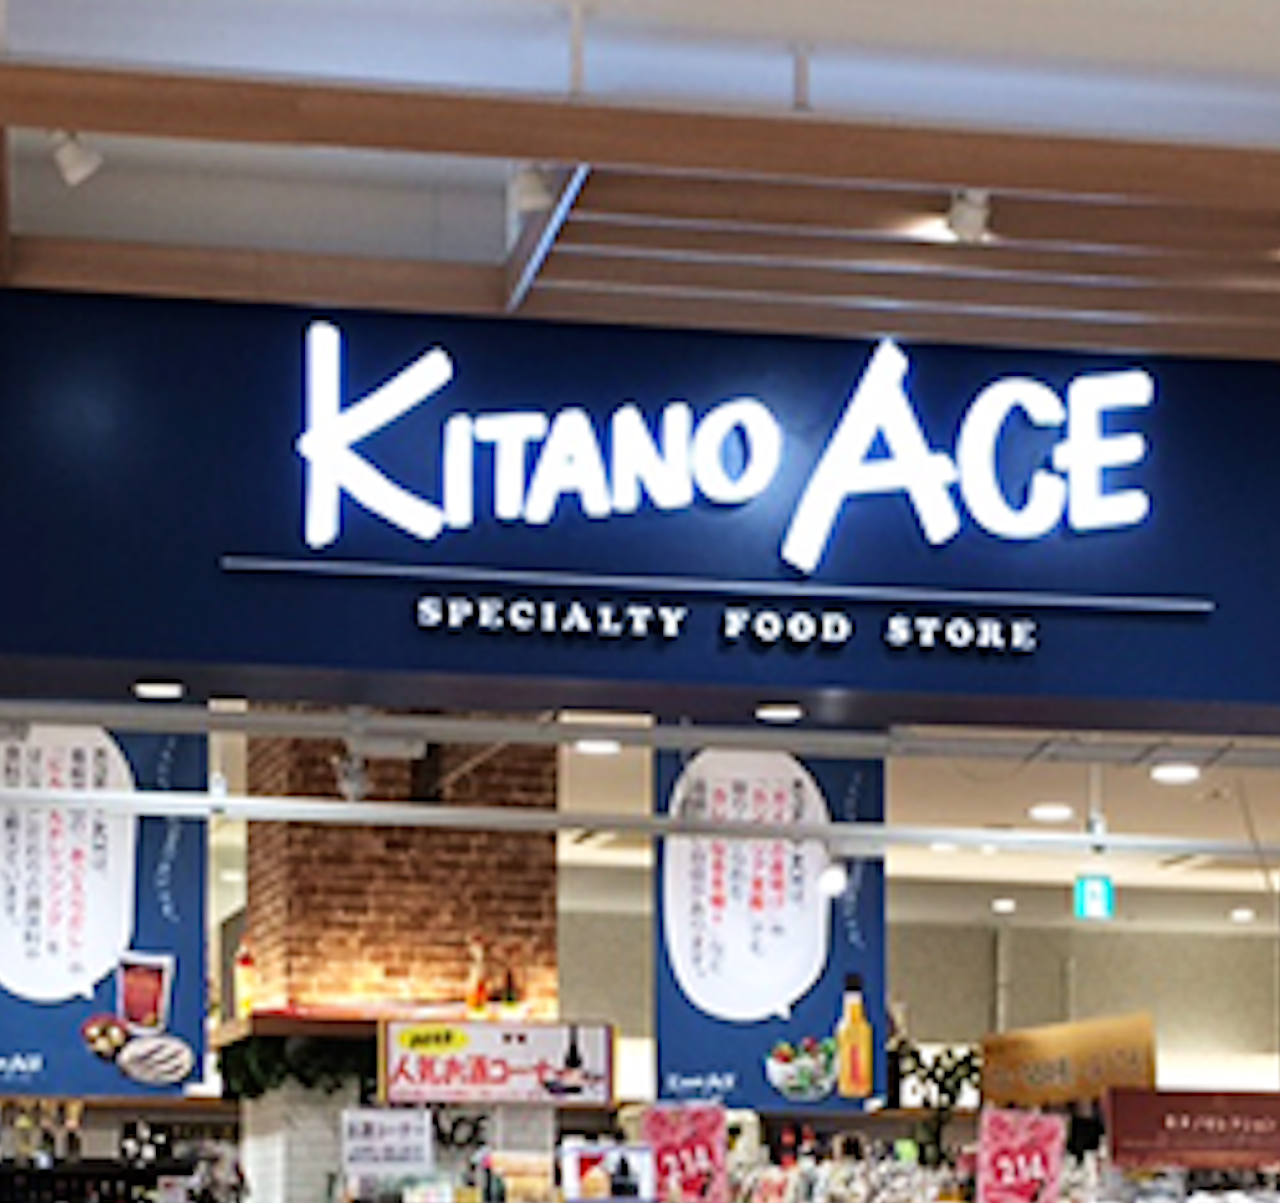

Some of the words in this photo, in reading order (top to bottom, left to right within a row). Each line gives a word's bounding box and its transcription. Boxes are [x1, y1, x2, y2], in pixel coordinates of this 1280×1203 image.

[297, 321, 783, 549] KITANO
[781, 336, 1155, 575] ACE
[417, 595, 688, 640] SPECIALTY
[723, 606, 853, 645] FOOD
[885, 612, 1038, 654] STORE
